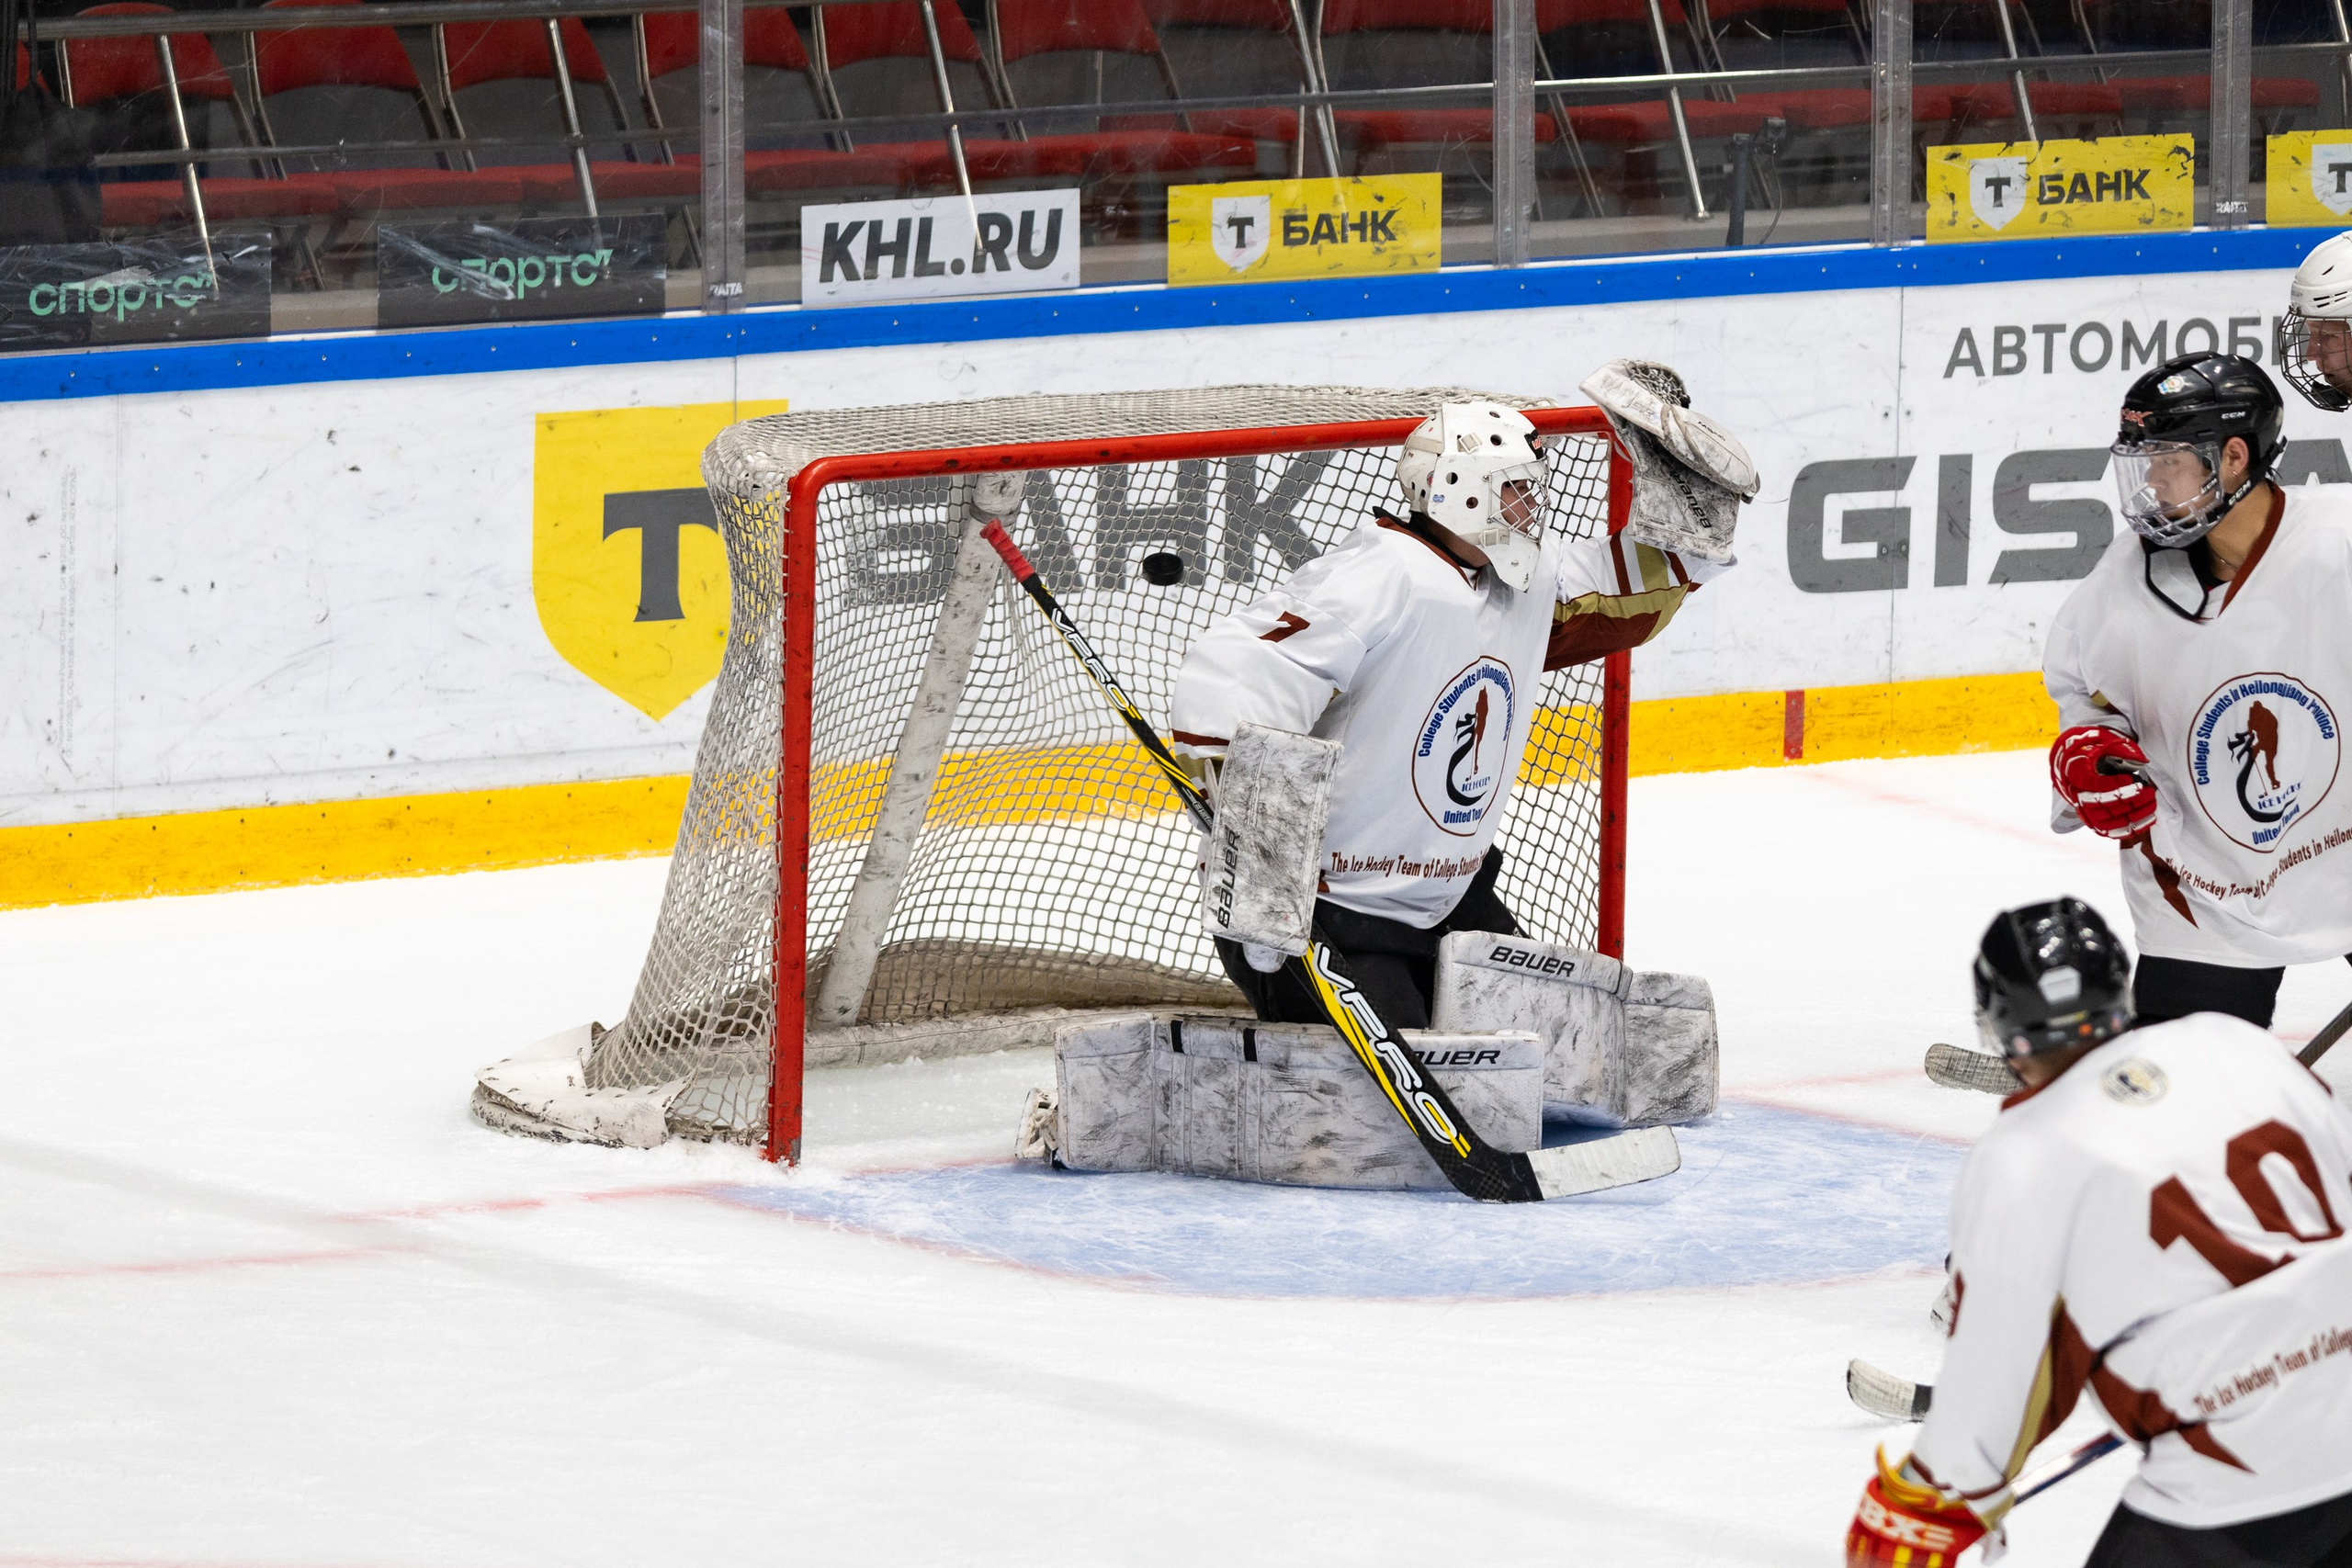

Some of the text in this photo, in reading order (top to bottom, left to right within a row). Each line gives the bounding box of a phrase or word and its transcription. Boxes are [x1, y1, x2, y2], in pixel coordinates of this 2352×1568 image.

[2039, 169, 2151, 206] БАНК
[820, 208, 1063, 283] KHL.RU
[1283, 209, 1398, 247] БАНК
[2222, 411, 2245, 420] CCM
[2228, 479, 2252, 505] CCM
[2229, 688, 2241, 703] in
[2239, 680, 2310, 706] Heilongjiang
[1418, 712, 1444, 757] College
[1438, 673, 1476, 714] Students
[2196, 694, 2233, 740] Students
[2194, 740, 2211, 786] College
[1443, 810, 1471, 823] United
[2257, 797, 2276, 810] ICE
[1217, 829, 1240, 929] BAUER
[1332, 852, 1348, 872] The
[1351, 855, 1363, 871] Ice
[1362, 856, 1395, 877] Hockey
[1397, 855, 1421, 876] Team
[1424, 858, 1435, 877] of
[2193, 874, 2227, 900] Hockey
[2312, 838, 2323, 856] in
[1489, 946, 1575, 977] BAUER
[2148, 1116, 2346, 1289] 10
